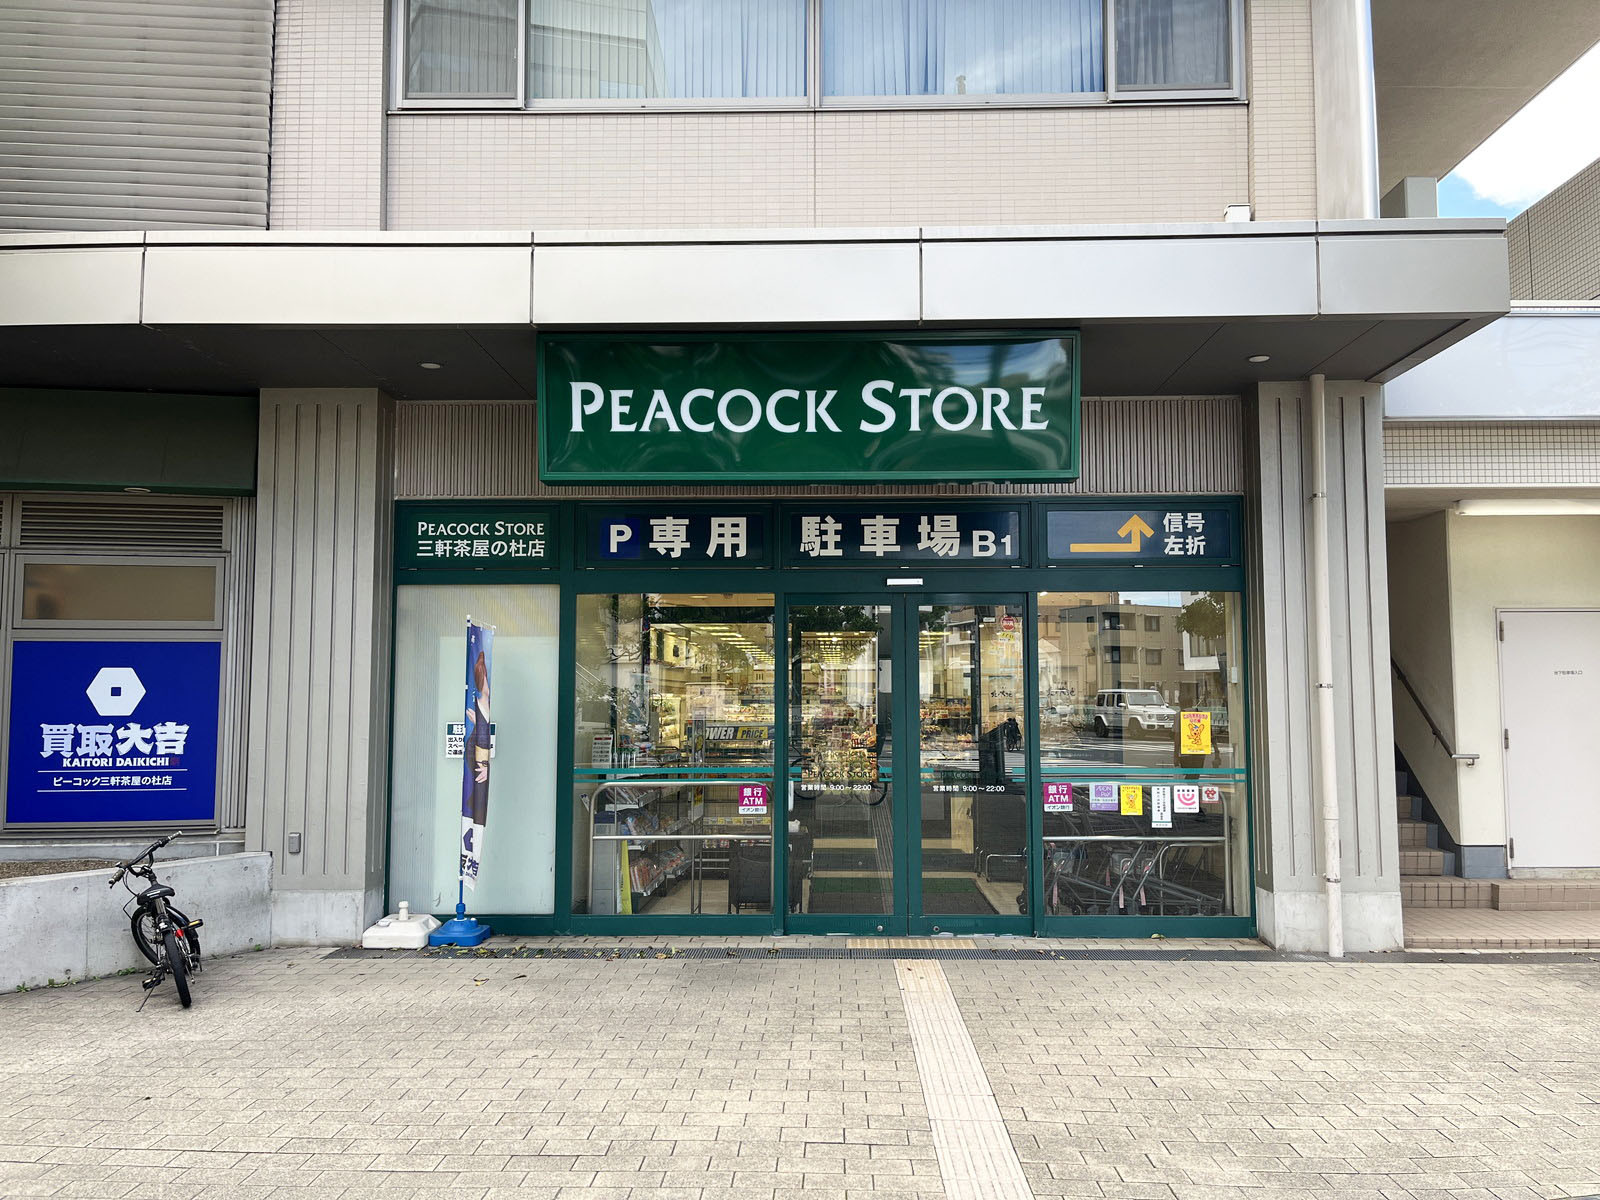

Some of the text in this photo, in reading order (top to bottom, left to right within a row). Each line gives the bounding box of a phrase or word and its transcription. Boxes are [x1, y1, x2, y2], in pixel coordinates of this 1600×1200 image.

[569, 380, 1048, 433] PEACOCK STORE
[417, 521, 544, 536] PEACOCK STORE
[1163, 512, 1205, 533] 信号
[609, 516, 747, 558] P 専用
[799, 514, 1013, 558] 駐車場 B1
[417, 539, 545, 558] 三軒茶屋の杜店
[1163, 535, 1206, 556] 左折
[39, 721, 190, 758] 買取大吉
[741, 729, 764, 739] PRICE
[62, 757, 113, 768] KAITORI
[115, 756, 170, 767] DAIKICHI
[53, 775, 172, 787] ピーコック三軒茶屋の杜店
[743, 787, 762, 797] 銀行
[1047, 784, 1068, 794] 銀行
[743, 797, 764, 806] ATM
[1047, 794, 1069, 803] ATM
